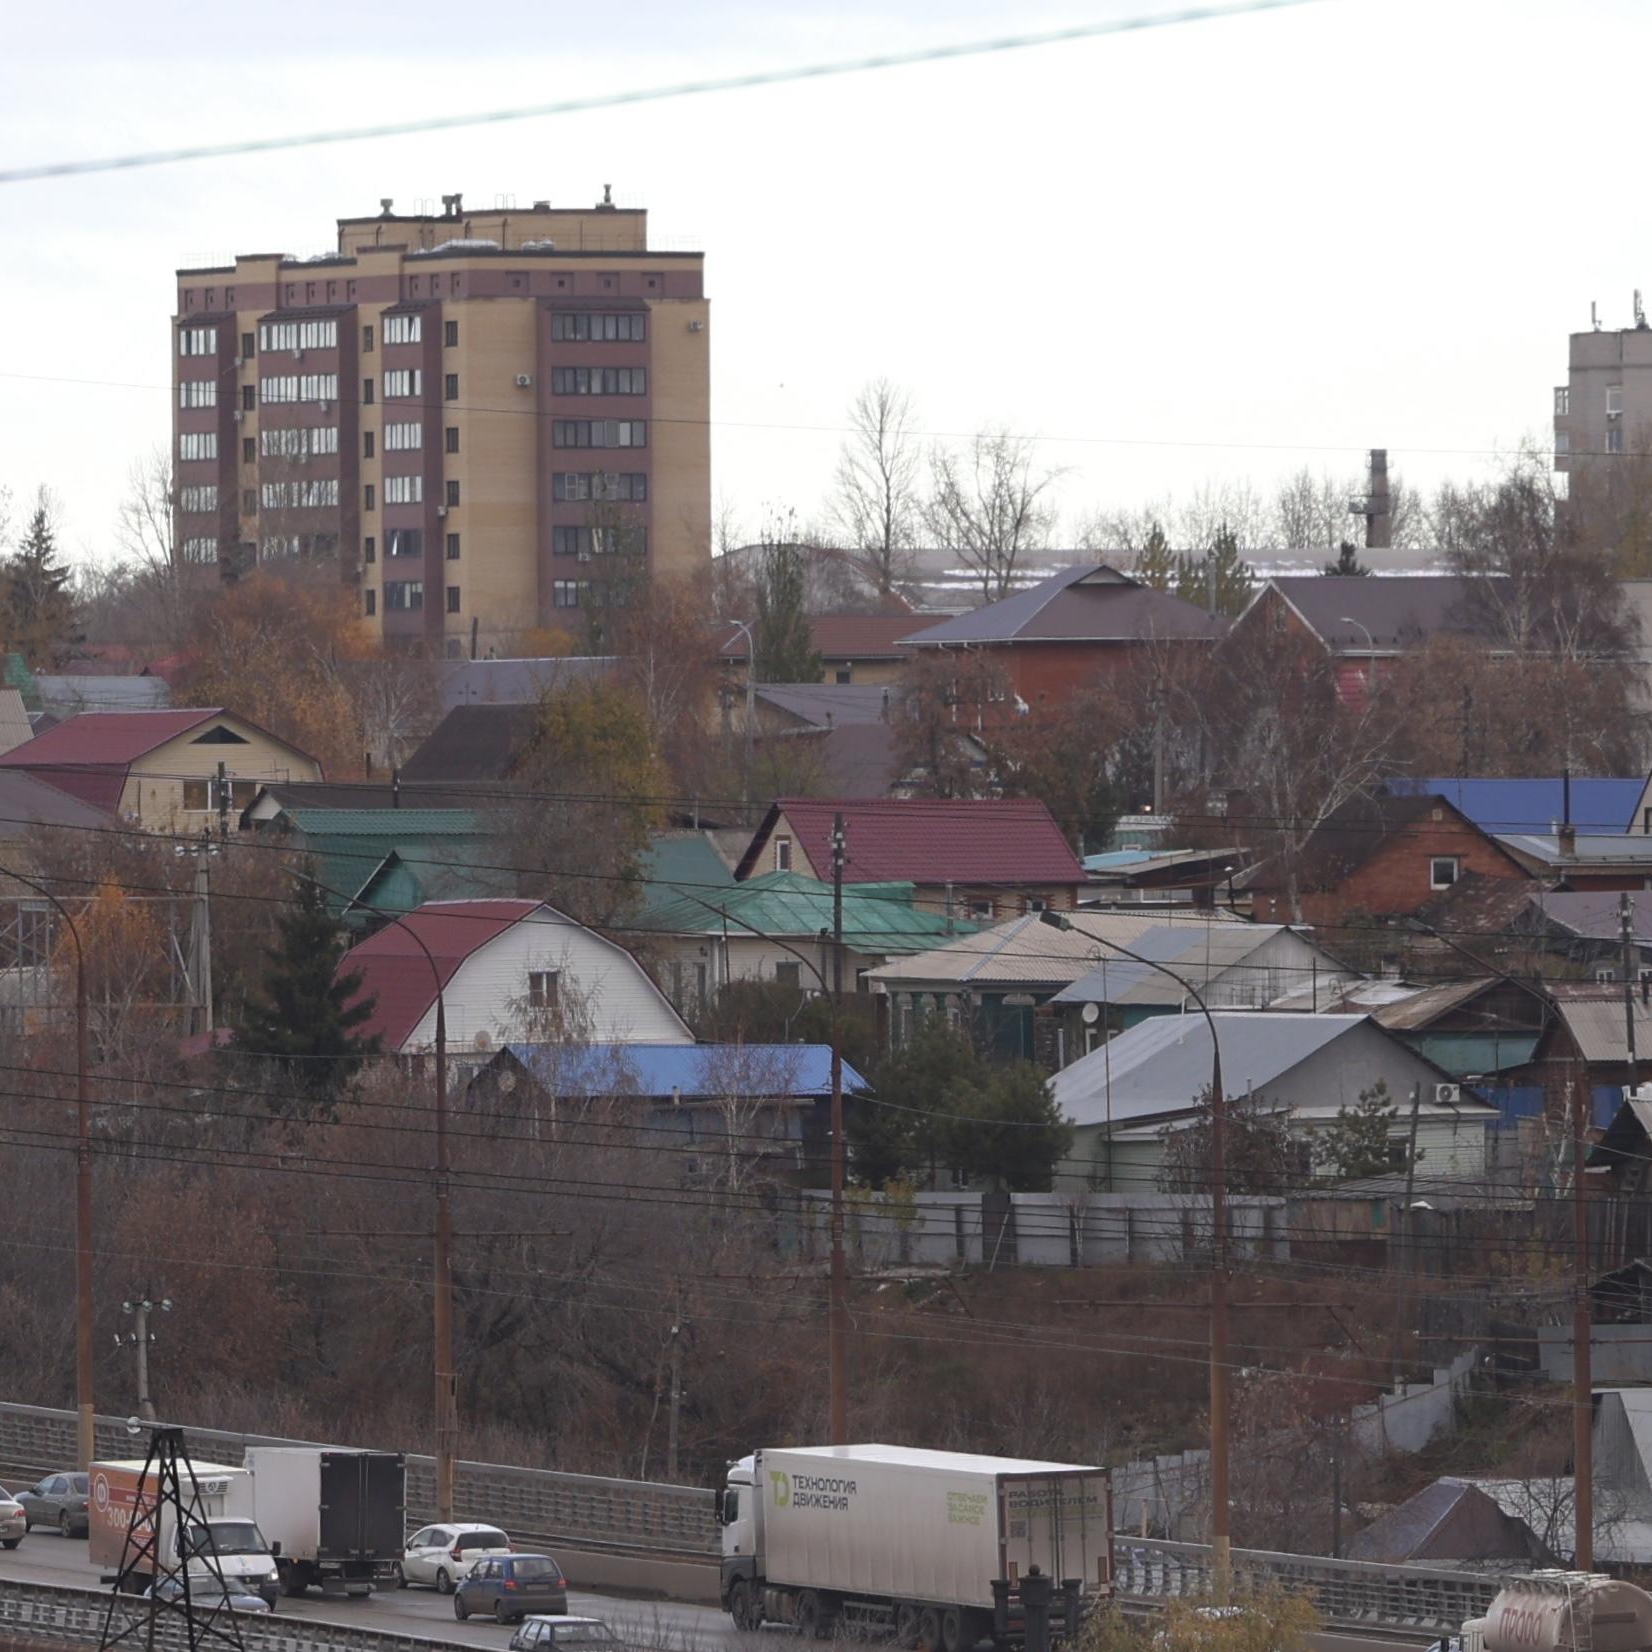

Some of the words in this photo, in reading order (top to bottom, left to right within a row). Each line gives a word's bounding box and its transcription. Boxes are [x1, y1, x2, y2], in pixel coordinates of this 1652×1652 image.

[792, 1474, 857, 1495] ТЕХНОЛОГИЯ
[1008, 1488, 1064, 1498] РАБОТА
[792, 1492, 849, 1511] ДВИЖЕНИЯ
[1008, 1496, 1098, 1508] ВОДИТЕЛЕМ
